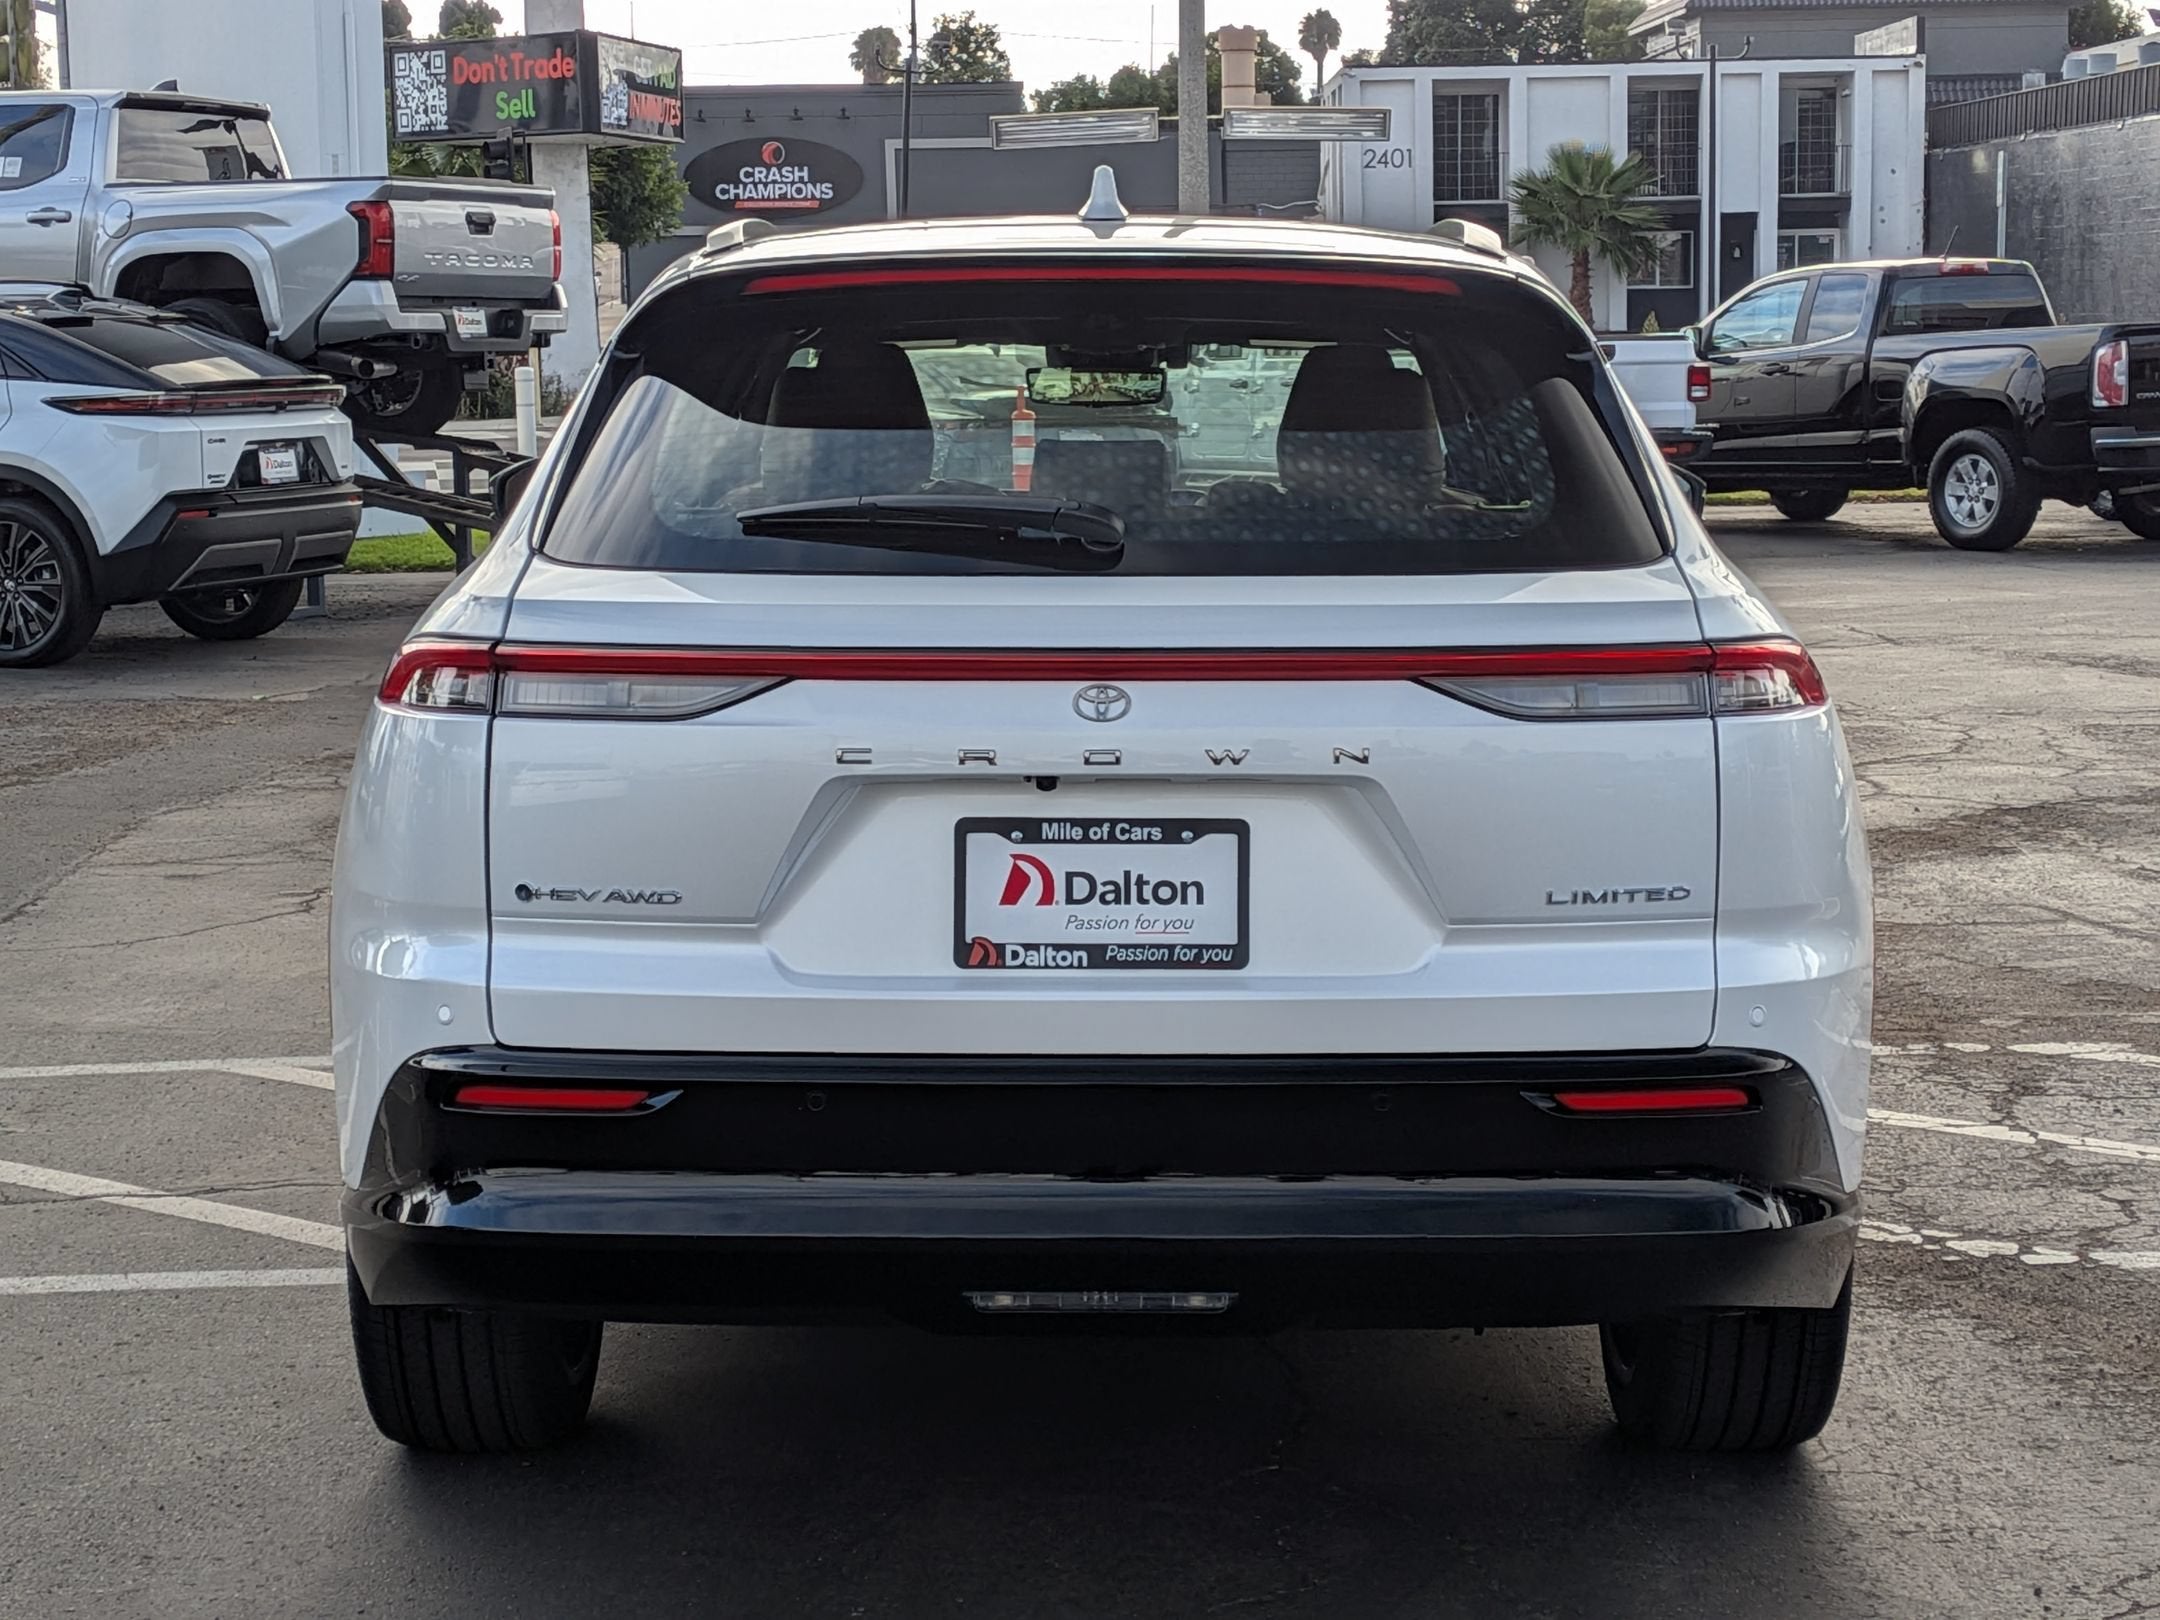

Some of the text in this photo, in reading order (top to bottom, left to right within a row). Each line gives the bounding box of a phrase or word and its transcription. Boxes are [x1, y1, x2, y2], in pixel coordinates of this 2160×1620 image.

[453, 53, 509, 85] Don't
[510, 47, 575, 80] Trade
[496, 88, 536, 120] Sell
[1363, 148, 1413, 169] 2401
[739, 166, 809, 183] CRASH
[715, 183, 834, 200] CHAMPIONS
[424, 252, 534, 269] TACOMA
[836, 747, 1370, 766] CROWN
[1041, 822, 1163, 841] Mile of Cars
[602, 887, 683, 905] AWD
[1064, 870, 1204, 906] Dalton
[1545, 885, 1691, 906] LIMITED
[1064, 913, 1194, 932] Passion for you
[1005, 944, 1233, 967] Dalton Passion for you
